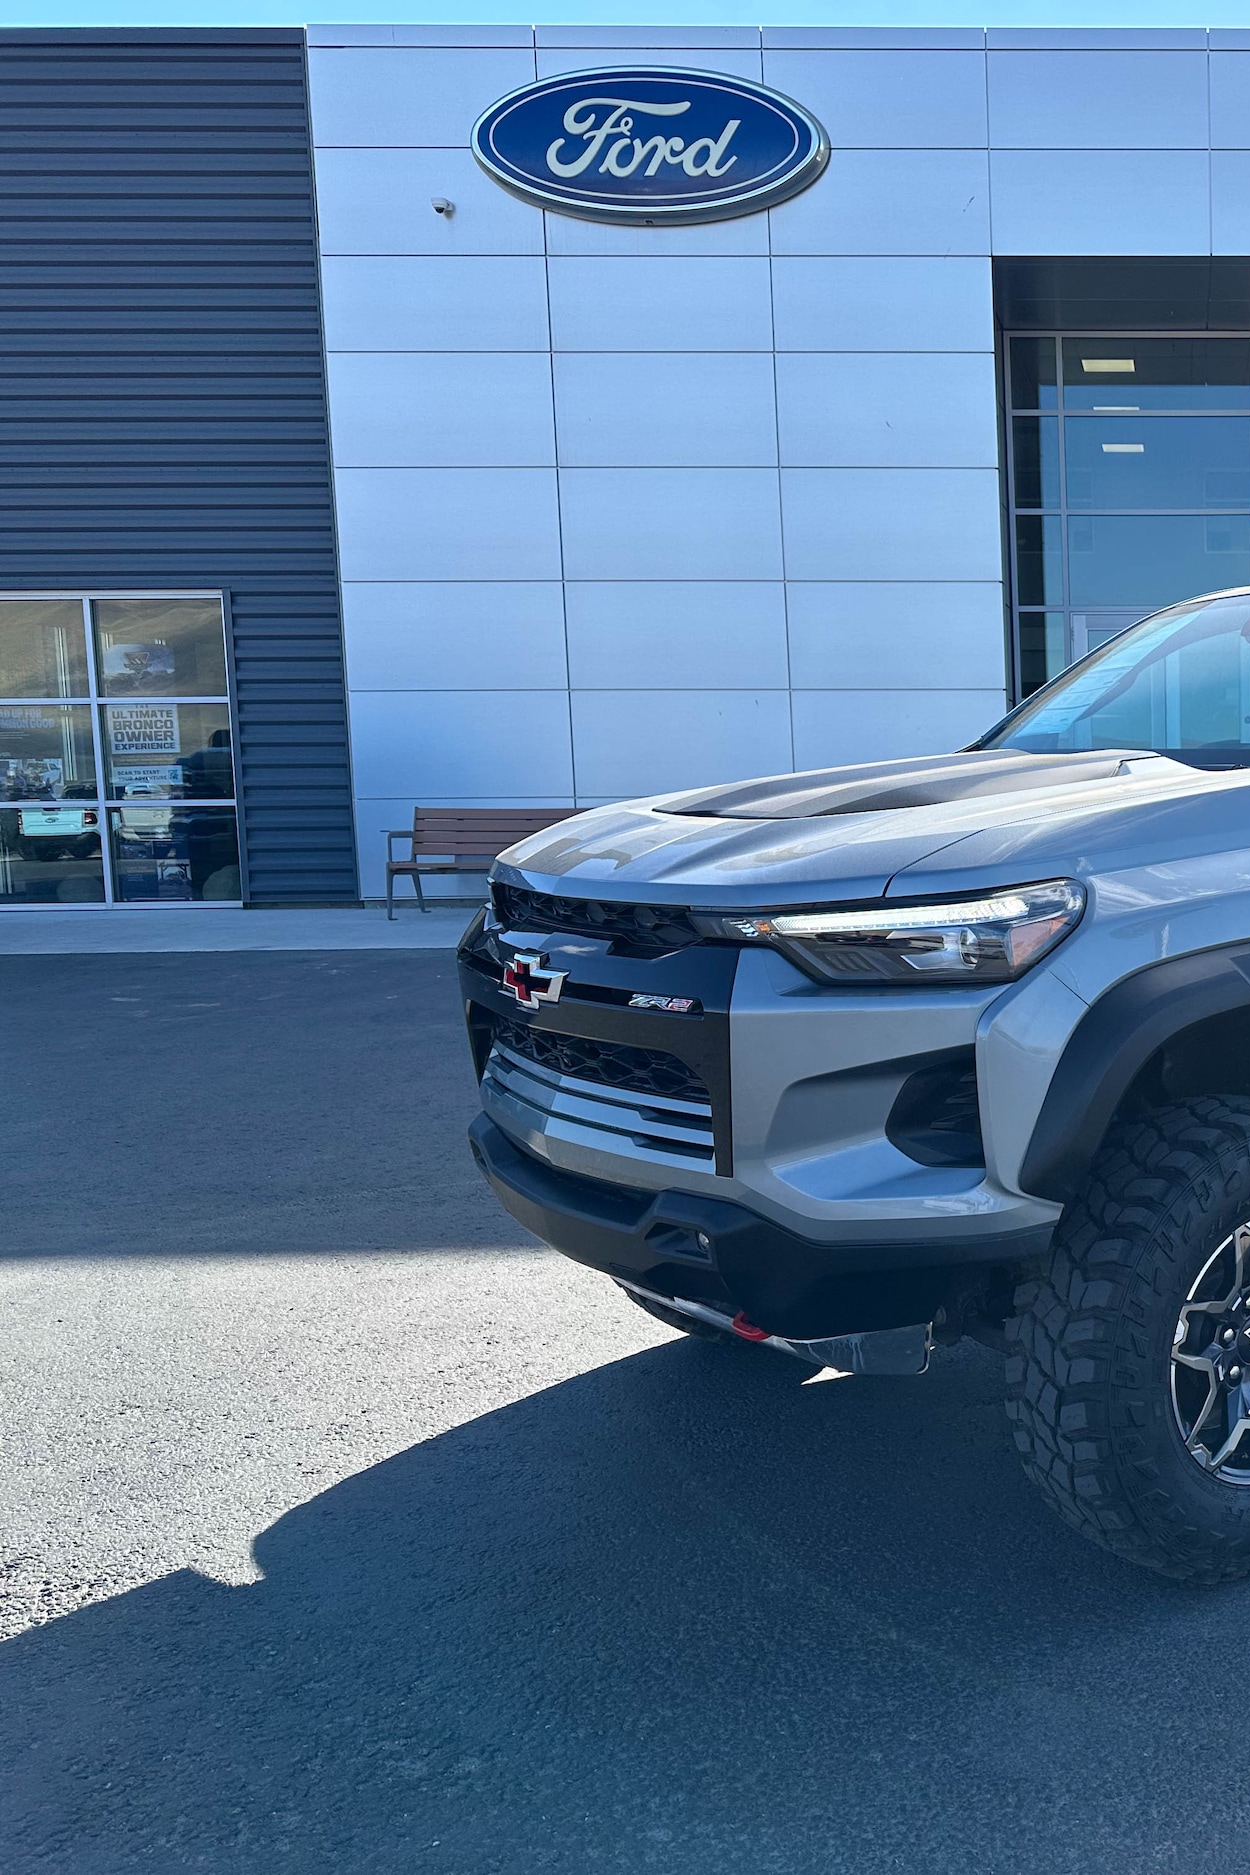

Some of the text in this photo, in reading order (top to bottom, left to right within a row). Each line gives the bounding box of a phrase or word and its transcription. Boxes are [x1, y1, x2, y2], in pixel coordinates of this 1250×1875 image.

[546, 97, 741, 178] Ford
[111, 709, 174, 720] ULTIMATE
[112, 719, 174, 731] BRONCO
[113, 730, 175, 742] OWNER
[114, 742, 176, 751] EXPERIENCE
[628, 993, 694, 1013] ZR2
